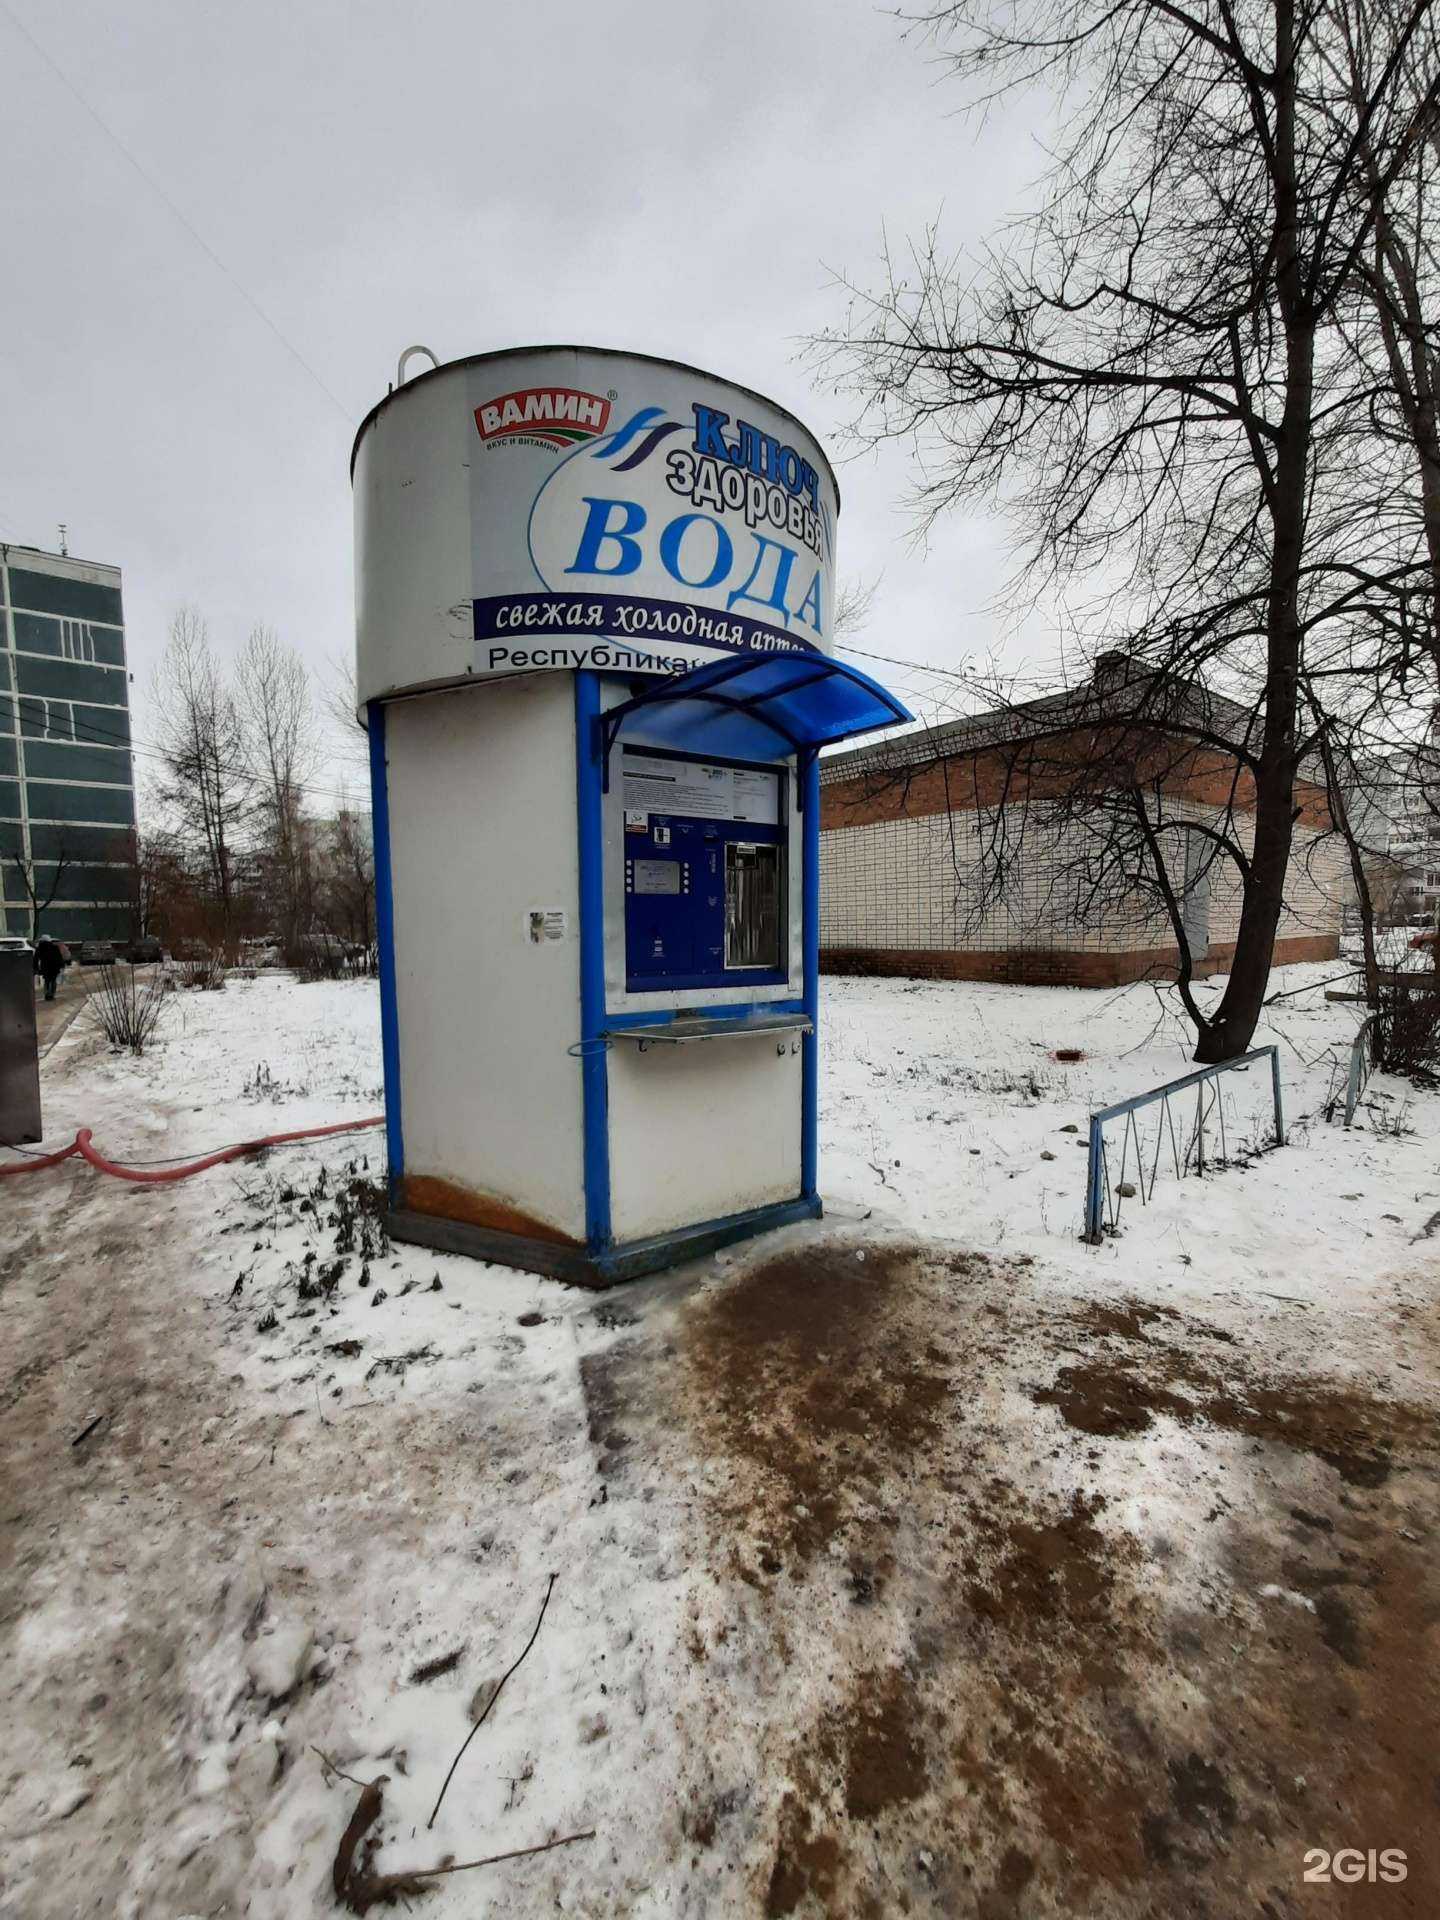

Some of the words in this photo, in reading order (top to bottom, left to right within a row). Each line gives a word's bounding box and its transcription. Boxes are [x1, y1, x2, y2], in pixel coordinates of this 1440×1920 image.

[480, 393, 604, 435] ВАМИН
[486, 438, 508, 451] ВКУС
[509, 437, 516, 446] И
[518, 437, 561, 454] ВИТАМИН
[691, 402, 820, 515] КЛЮЧ
[563, 496, 824, 637] ВОДА
[495, 601, 605, 629] свежая
[612, 604, 744, 647] холодная
